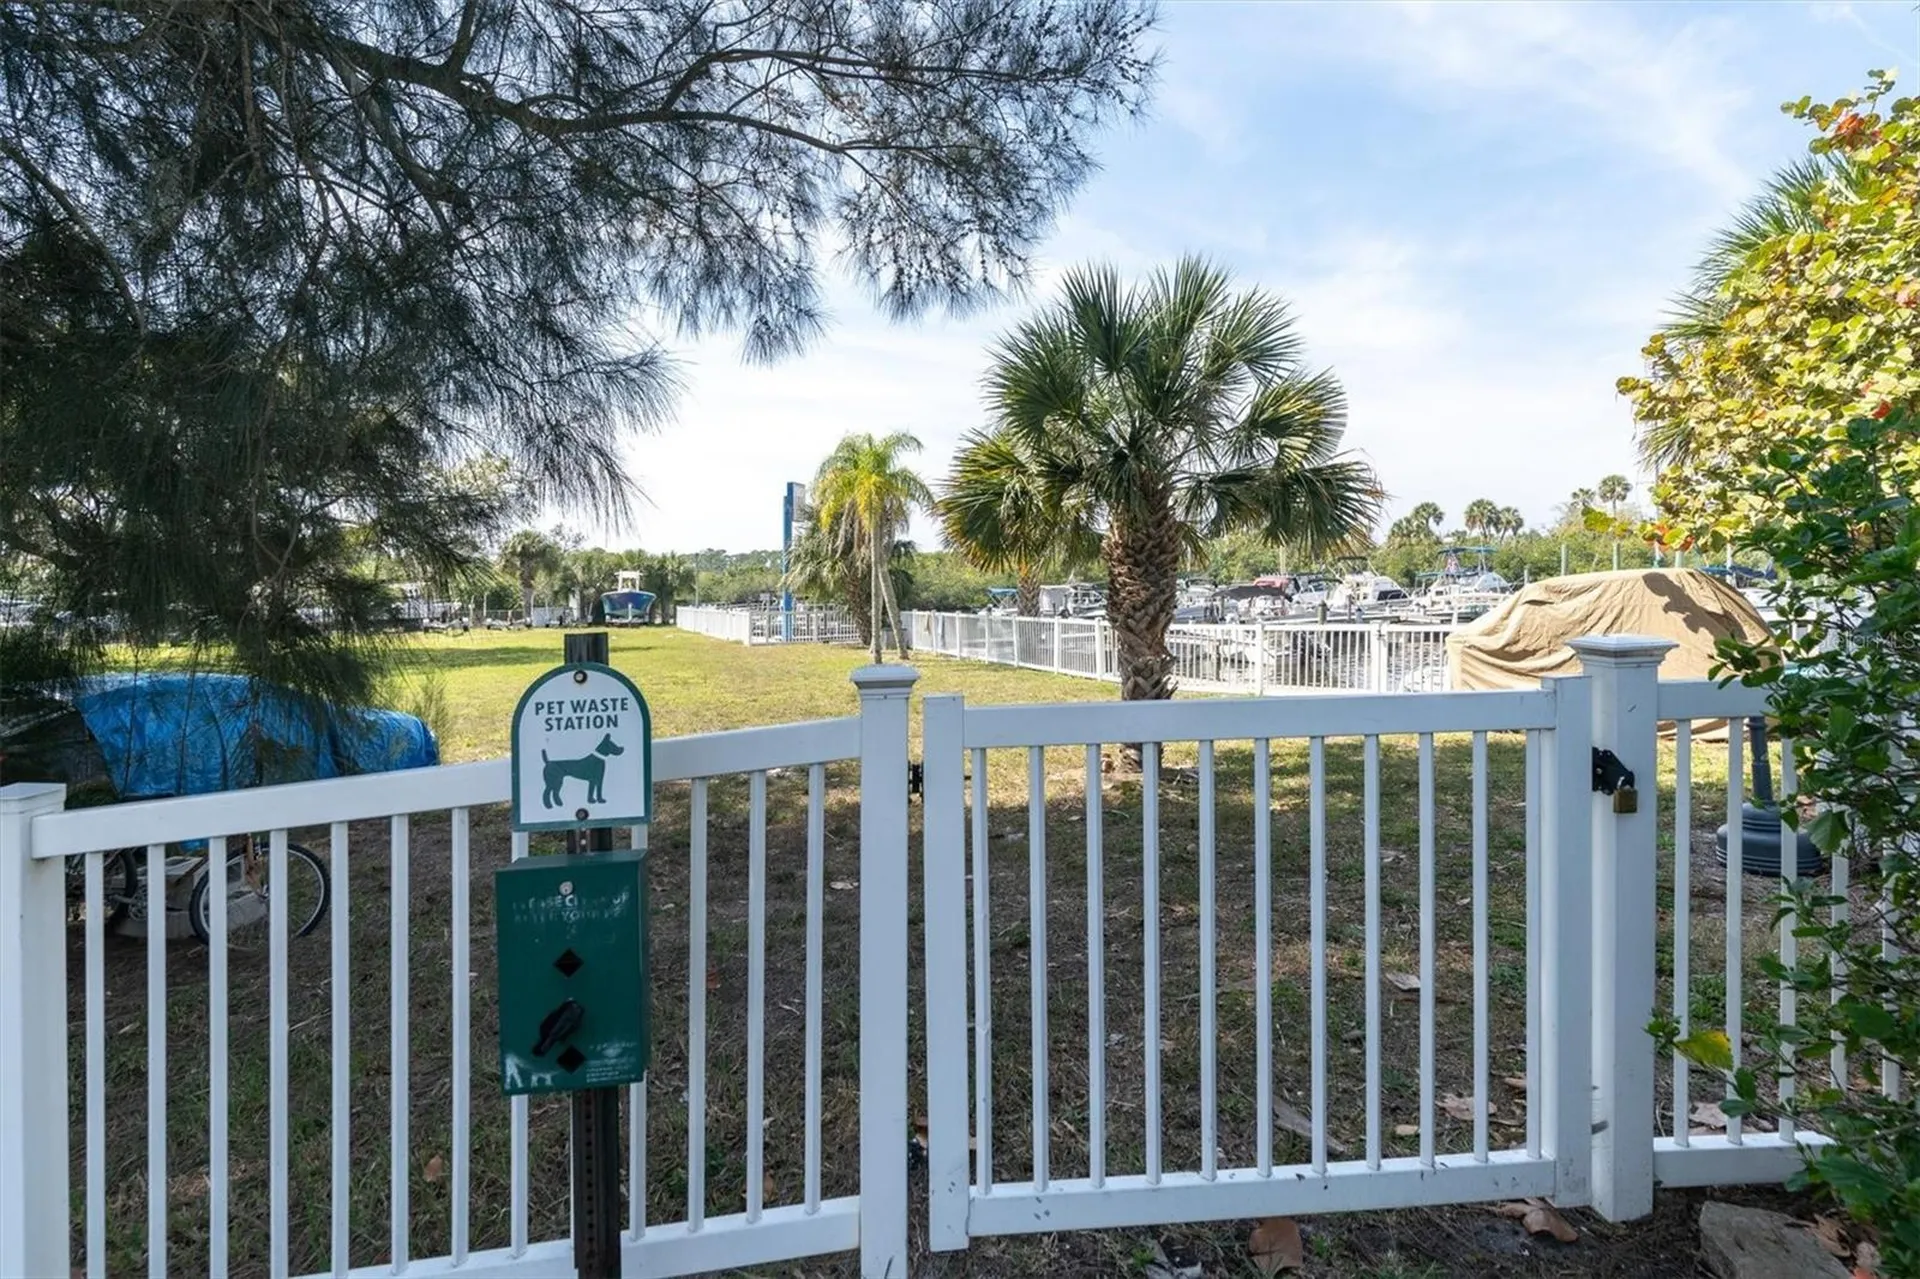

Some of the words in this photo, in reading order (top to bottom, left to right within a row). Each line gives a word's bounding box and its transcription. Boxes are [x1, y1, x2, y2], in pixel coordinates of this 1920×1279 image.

[534, 700, 566, 716] PET
[570, 697, 629, 714] WASTE
[544, 714, 619, 732] STATION
